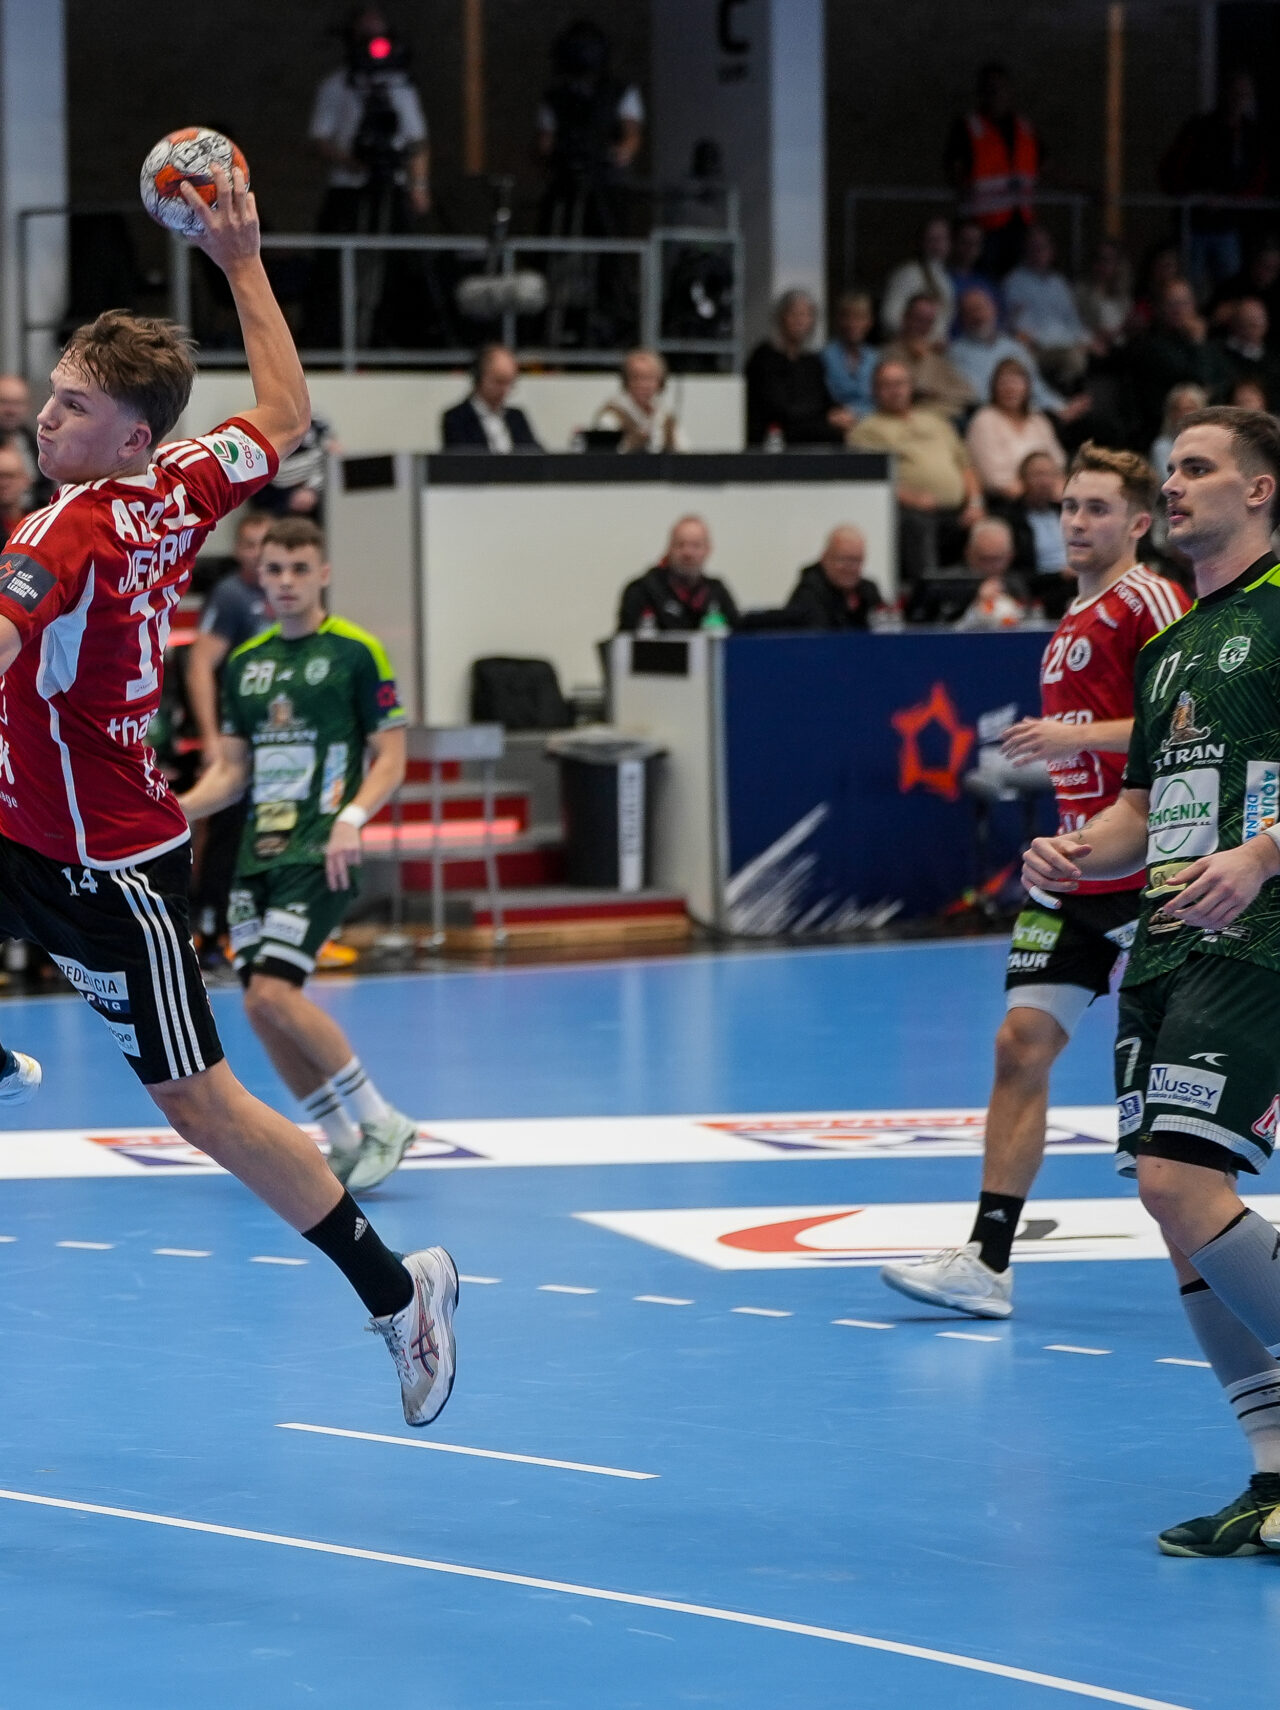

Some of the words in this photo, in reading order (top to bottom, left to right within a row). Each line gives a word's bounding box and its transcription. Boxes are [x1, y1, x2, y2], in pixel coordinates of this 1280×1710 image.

[7, 583, 28, 598] LEAGUE
[11, 577, 38, 599] EUROPEAN
[239, 659, 277, 696] 28
[1149, 651, 1182, 703] 17
[61, 867, 99, 896] 14
[1148, 1067, 1218, 1100] NUSSY
